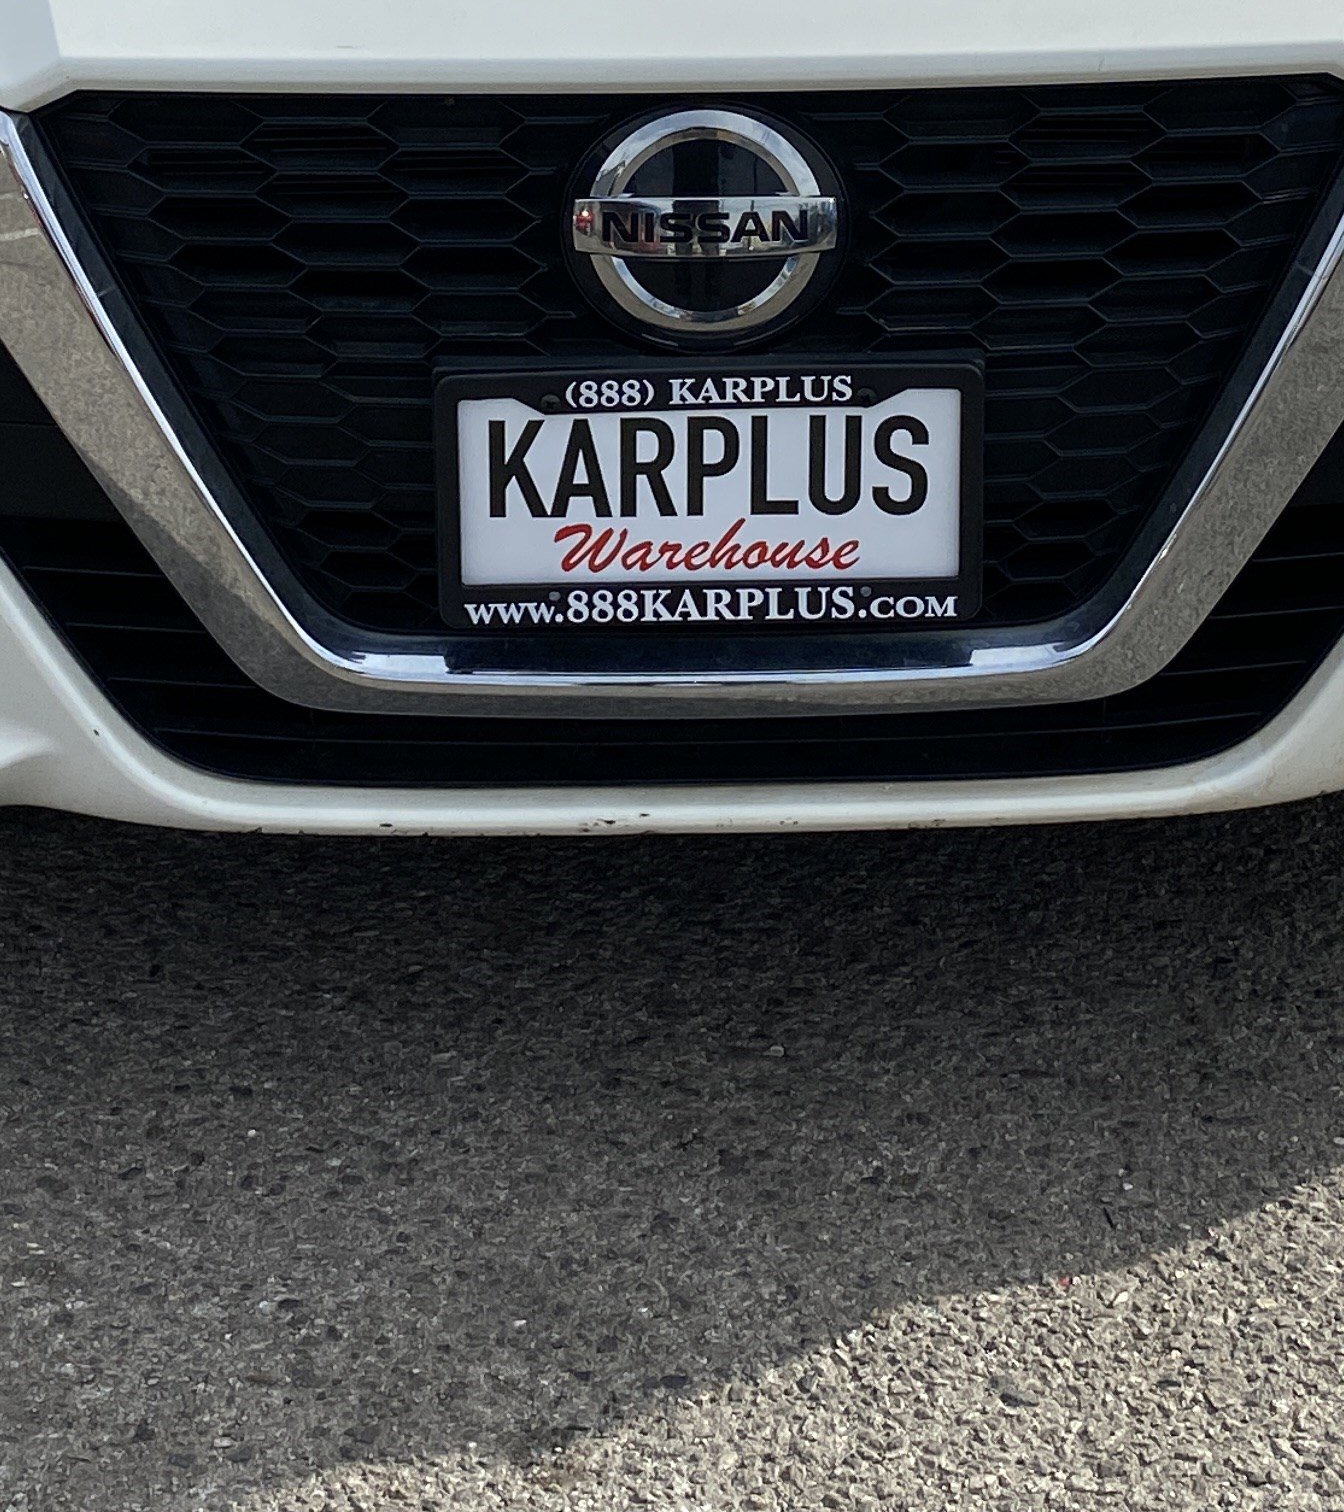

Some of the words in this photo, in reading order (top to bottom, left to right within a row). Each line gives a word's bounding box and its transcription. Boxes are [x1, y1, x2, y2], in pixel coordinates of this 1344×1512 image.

[601, 209, 808, 244] NISSAN
[565, 379, 655, 408] (888)
[668, 375, 853, 404] KARPLUS
[487, 413, 931, 519] KARPLUS
[553, 518, 861, 575] Warehouse
